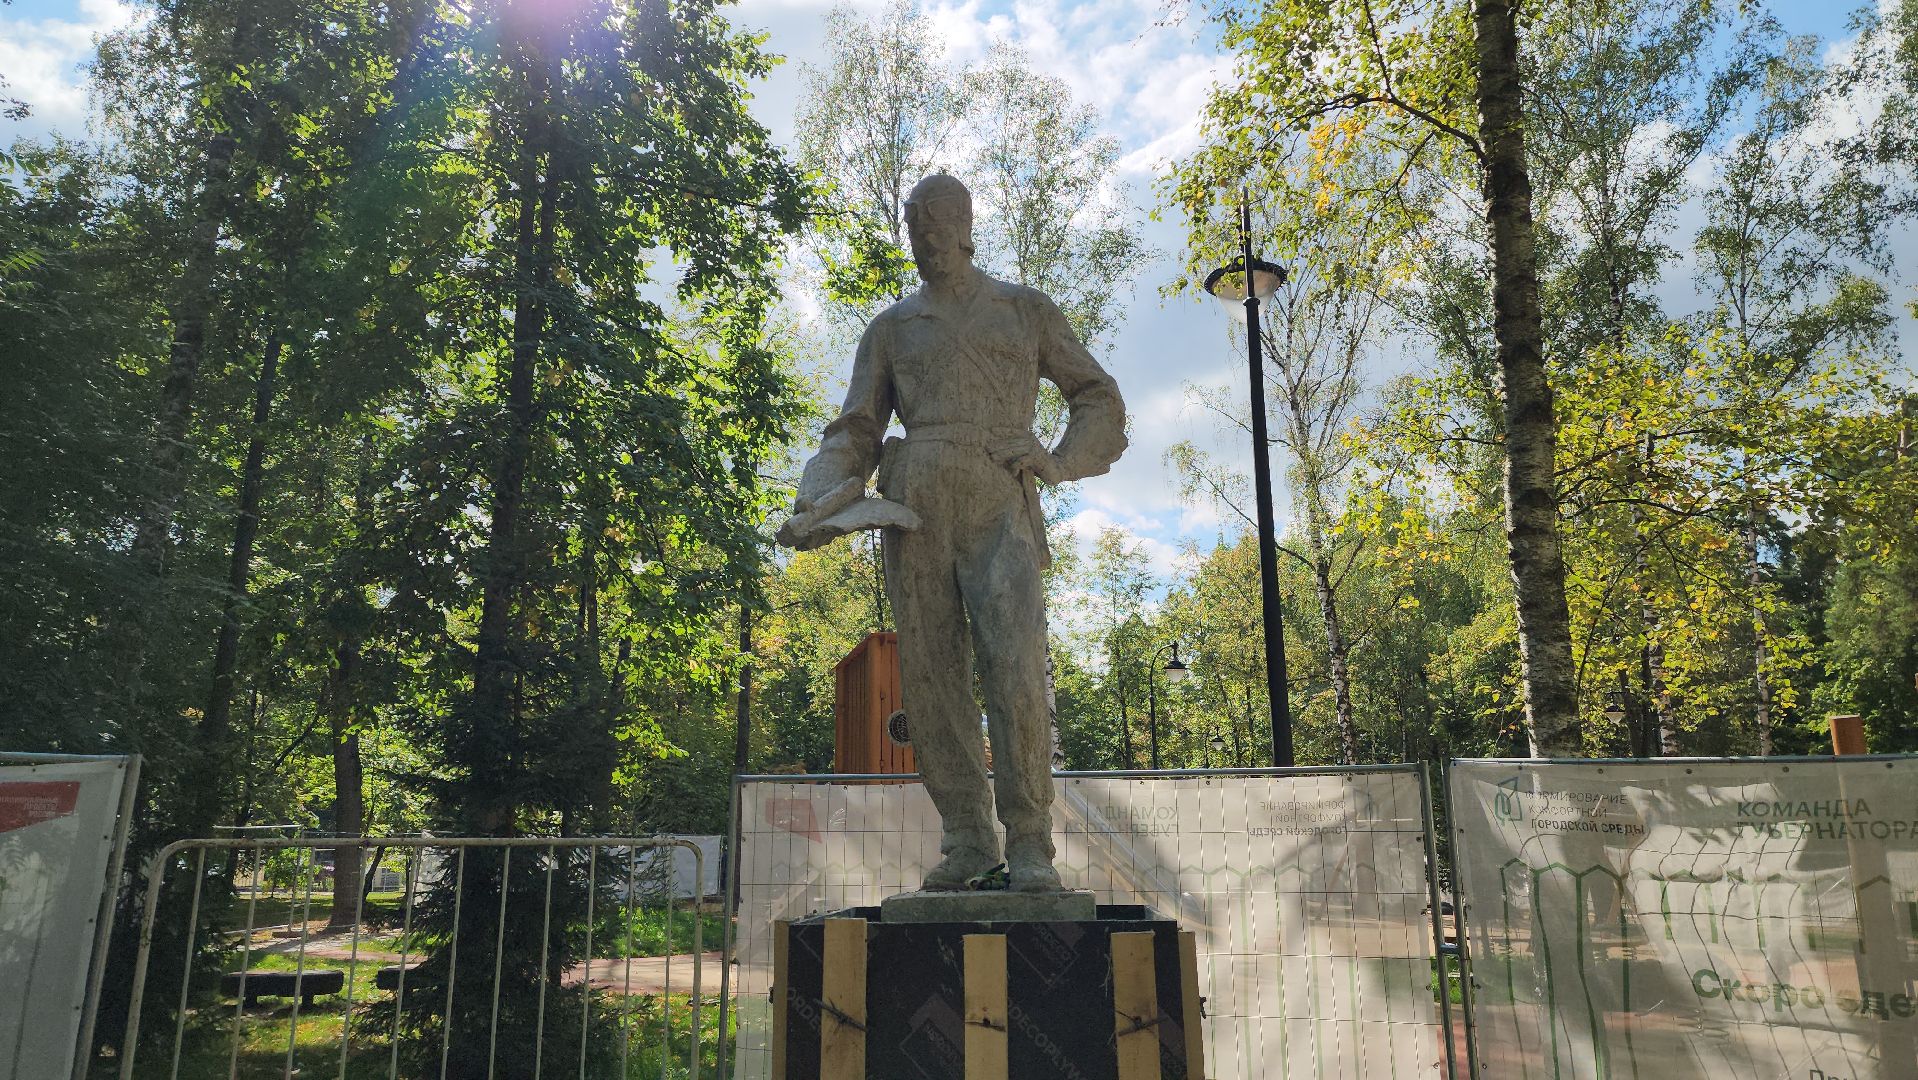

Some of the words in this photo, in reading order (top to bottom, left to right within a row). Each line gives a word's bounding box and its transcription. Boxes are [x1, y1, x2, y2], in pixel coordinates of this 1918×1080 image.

[1525, 790, 1628, 805] ФОРМИРОВАНИЕ
[1737, 797, 1872, 820] КОМАНДА
[1531, 817, 1599, 833] ГОРОДСКОЙ
[1601, 822, 1646, 836] СРЕДЫ
[1691, 967, 1826, 1013] Скоро
